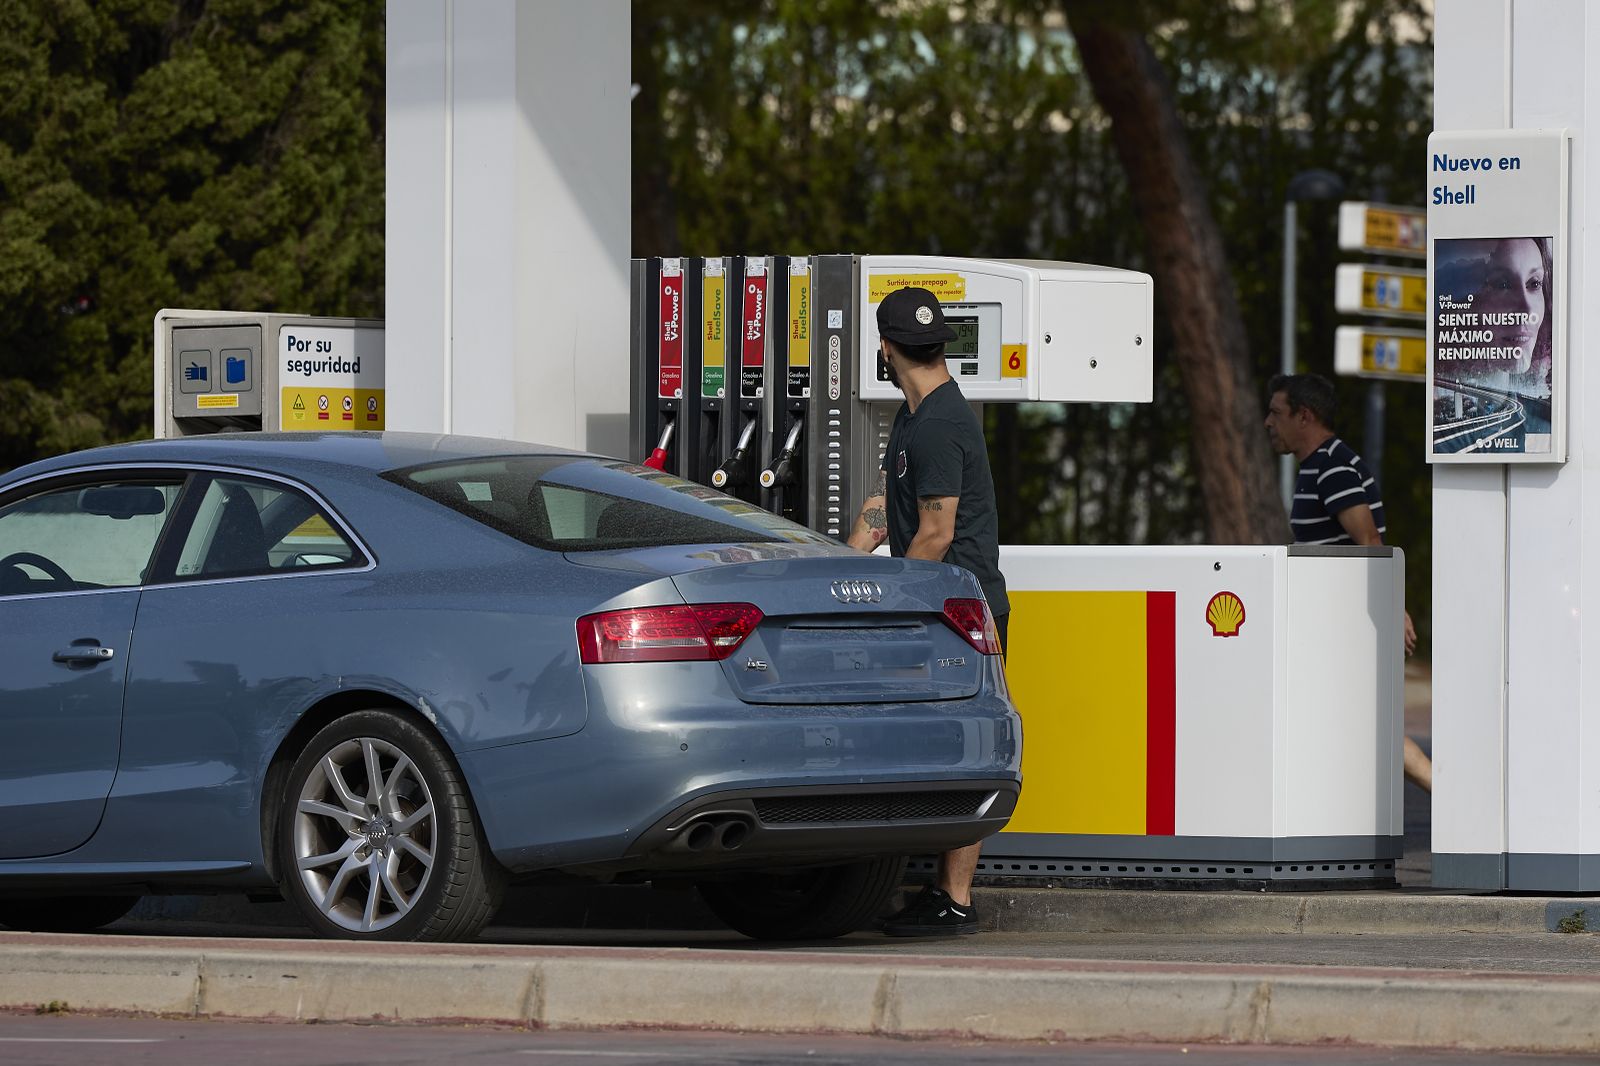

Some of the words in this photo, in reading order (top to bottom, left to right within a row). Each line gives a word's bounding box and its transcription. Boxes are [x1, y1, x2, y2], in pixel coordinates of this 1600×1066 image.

[1433, 154, 1492, 172] Nuevo
[1499, 156, 1521, 170] en
[1432, 185, 1475, 205] Shell
[670, 289, 679, 341] V-Power
[713, 288, 721, 341] FuelSave
[753, 288, 763, 340] V-Power
[799, 287, 807, 340] FuelSave
[1439, 302, 1472, 310] V-Power
[1438, 313, 1478, 327] SIENTE
[1483, 312, 1539, 327] NUESTRO
[287, 335, 312, 352] Por
[316, 339, 332, 353] su
[1438, 327, 1493, 344] MÁXIMO
[1008, 352, 1021, 370] 6
[1438, 346, 1523, 361] RENDIMIENTO
[287, 356, 361, 376] seguridad
[1493, 438, 1519, 449] WELL
[744, 657, 768, 671] A5
[937, 657, 966, 668] TFSI
